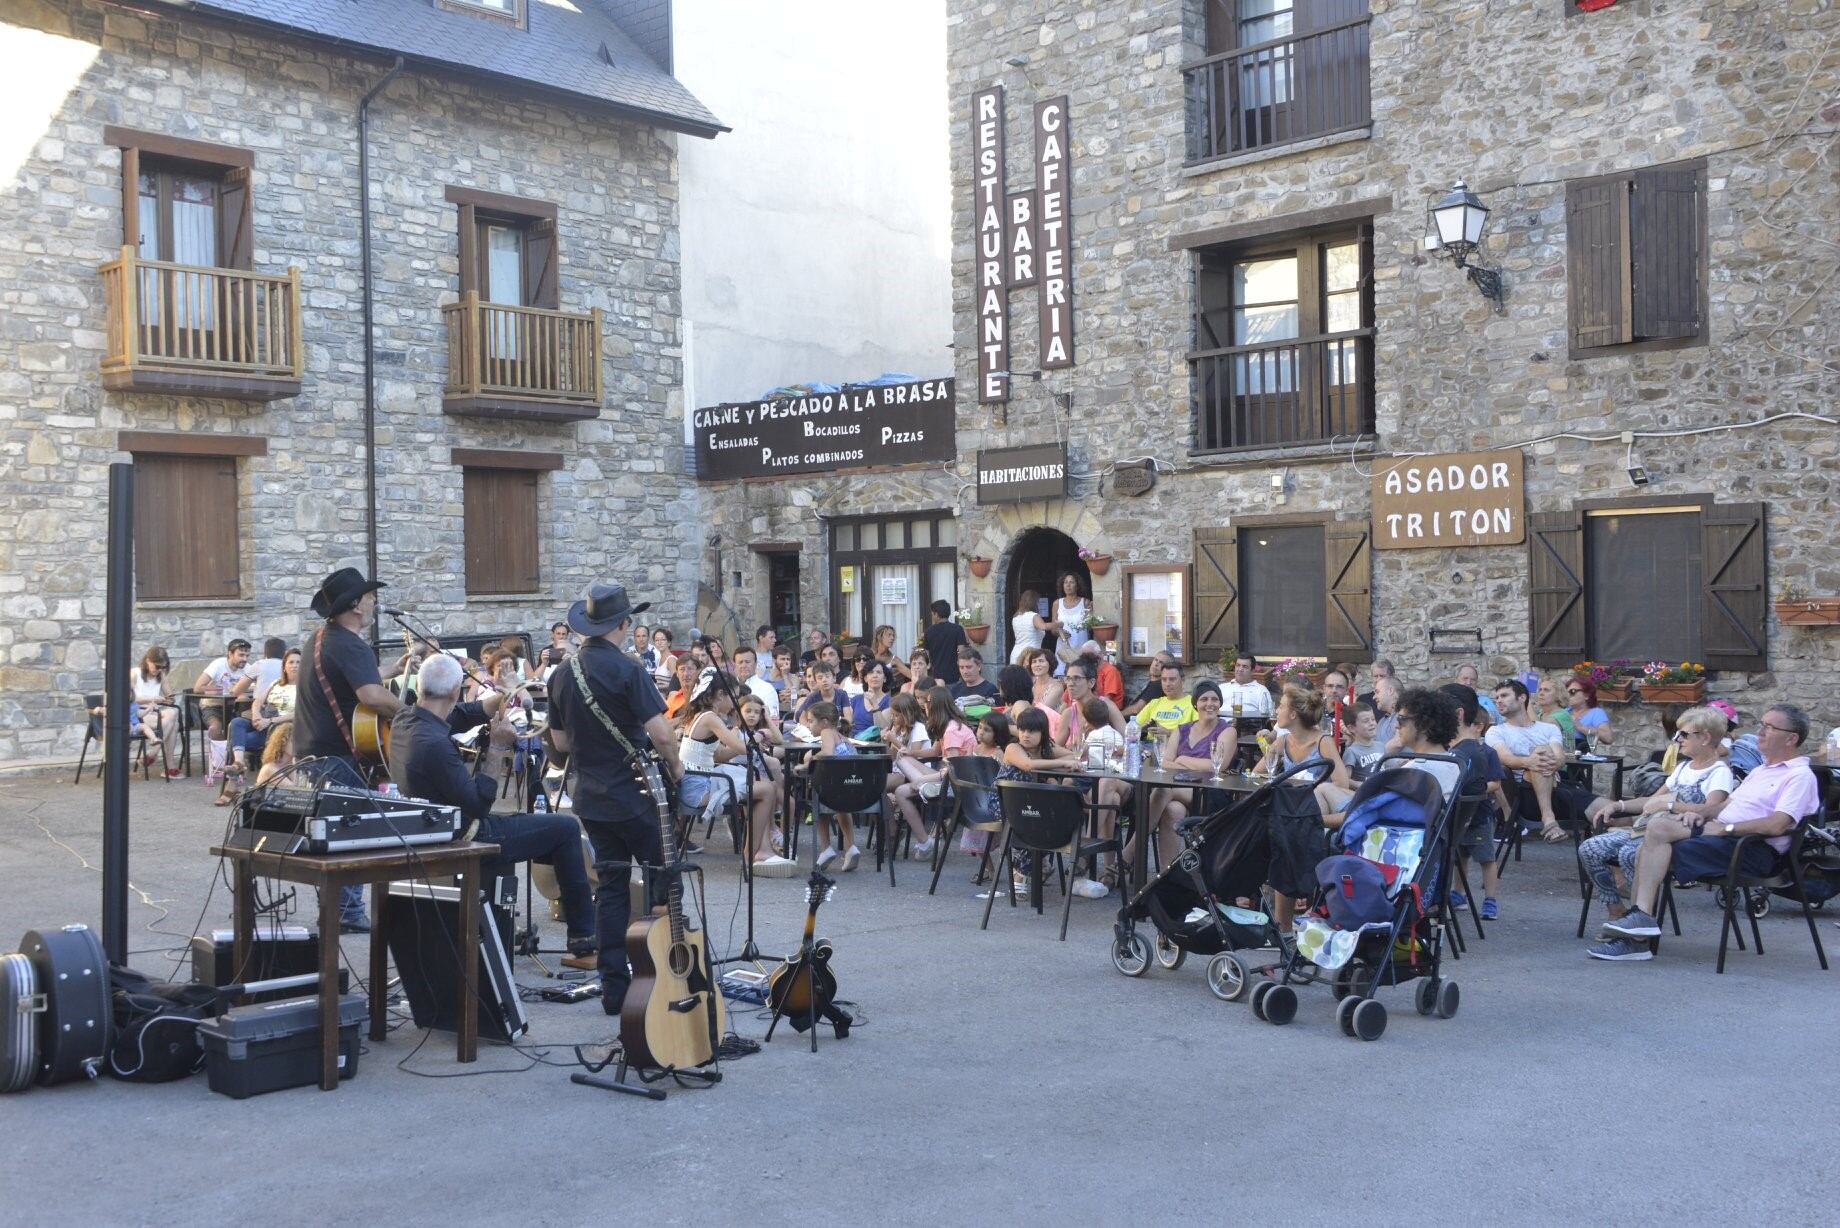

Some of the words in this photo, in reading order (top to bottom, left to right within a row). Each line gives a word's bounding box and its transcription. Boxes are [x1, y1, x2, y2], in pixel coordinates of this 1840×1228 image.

[979, 94, 1002, 397] RESTAURANTE
[1012, 197, 1033, 281] BAR
[1041, 105, 1067, 362] CAFETERIA
[694, 406, 740, 428] CARNE
[746, 409, 755, 424] Y
[760, 395, 833, 420] PESCADO
[838, 393, 849, 411] A
[854, 389, 876, 411] LA
[883, 381, 948, 404] BRASA
[979, 463, 1064, 485] HABITACIONES
[1385, 462, 1510, 495] ASADOR
[1386, 507, 1511, 538] TRITON
